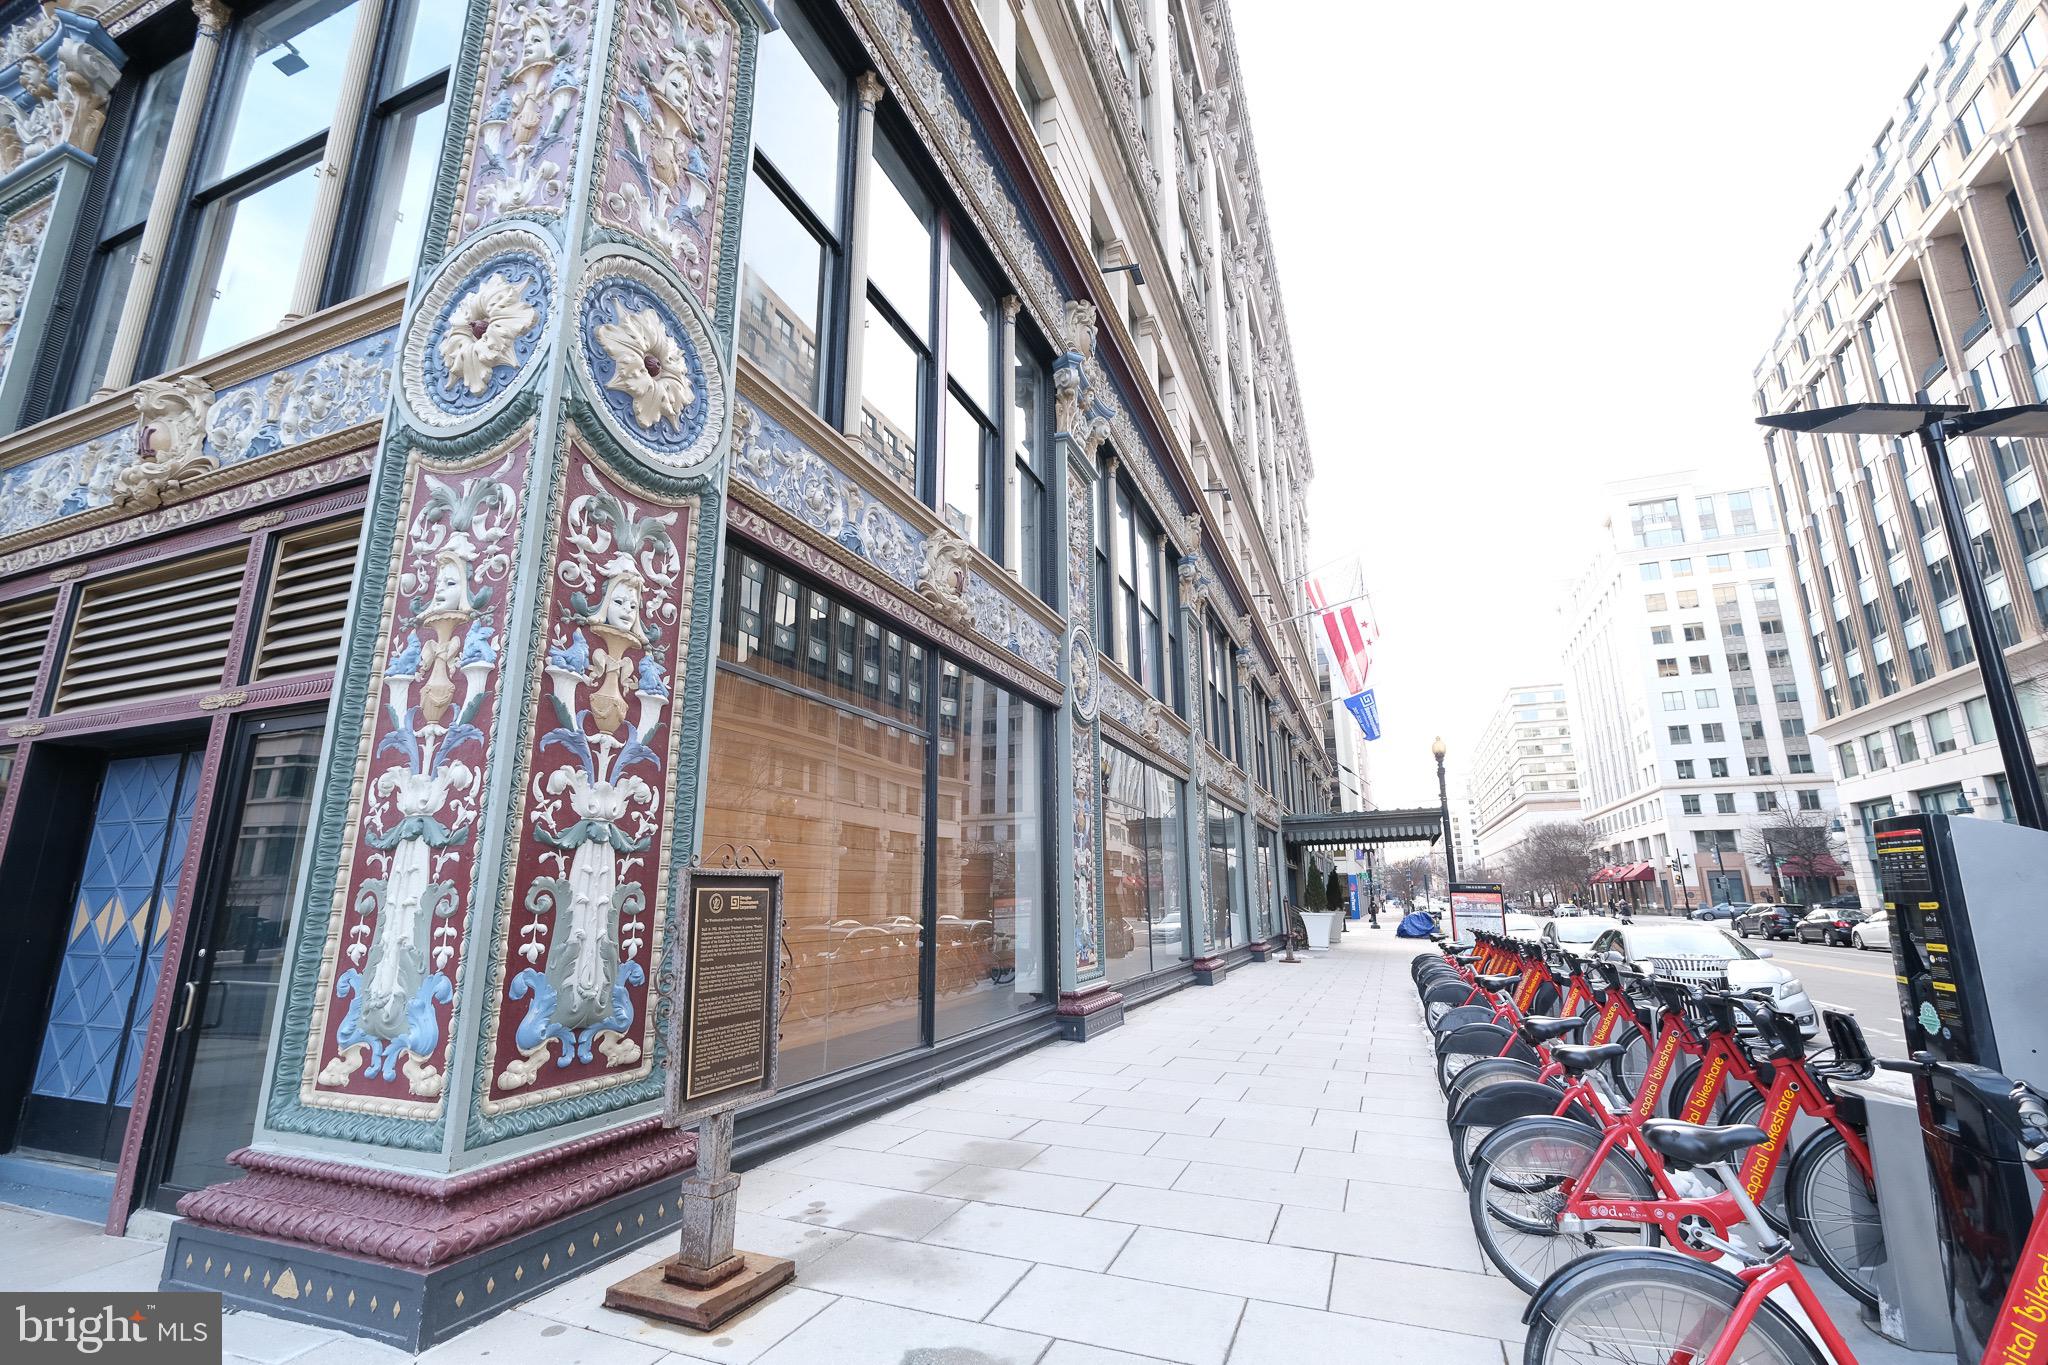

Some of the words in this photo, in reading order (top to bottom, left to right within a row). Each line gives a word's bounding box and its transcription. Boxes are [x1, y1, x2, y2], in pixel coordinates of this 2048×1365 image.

[1597, 1006, 1618, 1041] bikeshare
[1640, 1080, 1660, 1117] capital
[1651, 1035, 1676, 1081] bikeshare
[1690, 1057, 1725, 1108] bikeshare
[1757, 1089, 1795, 1152] bikeshare
[1745, 1151, 1771, 1201] capital
